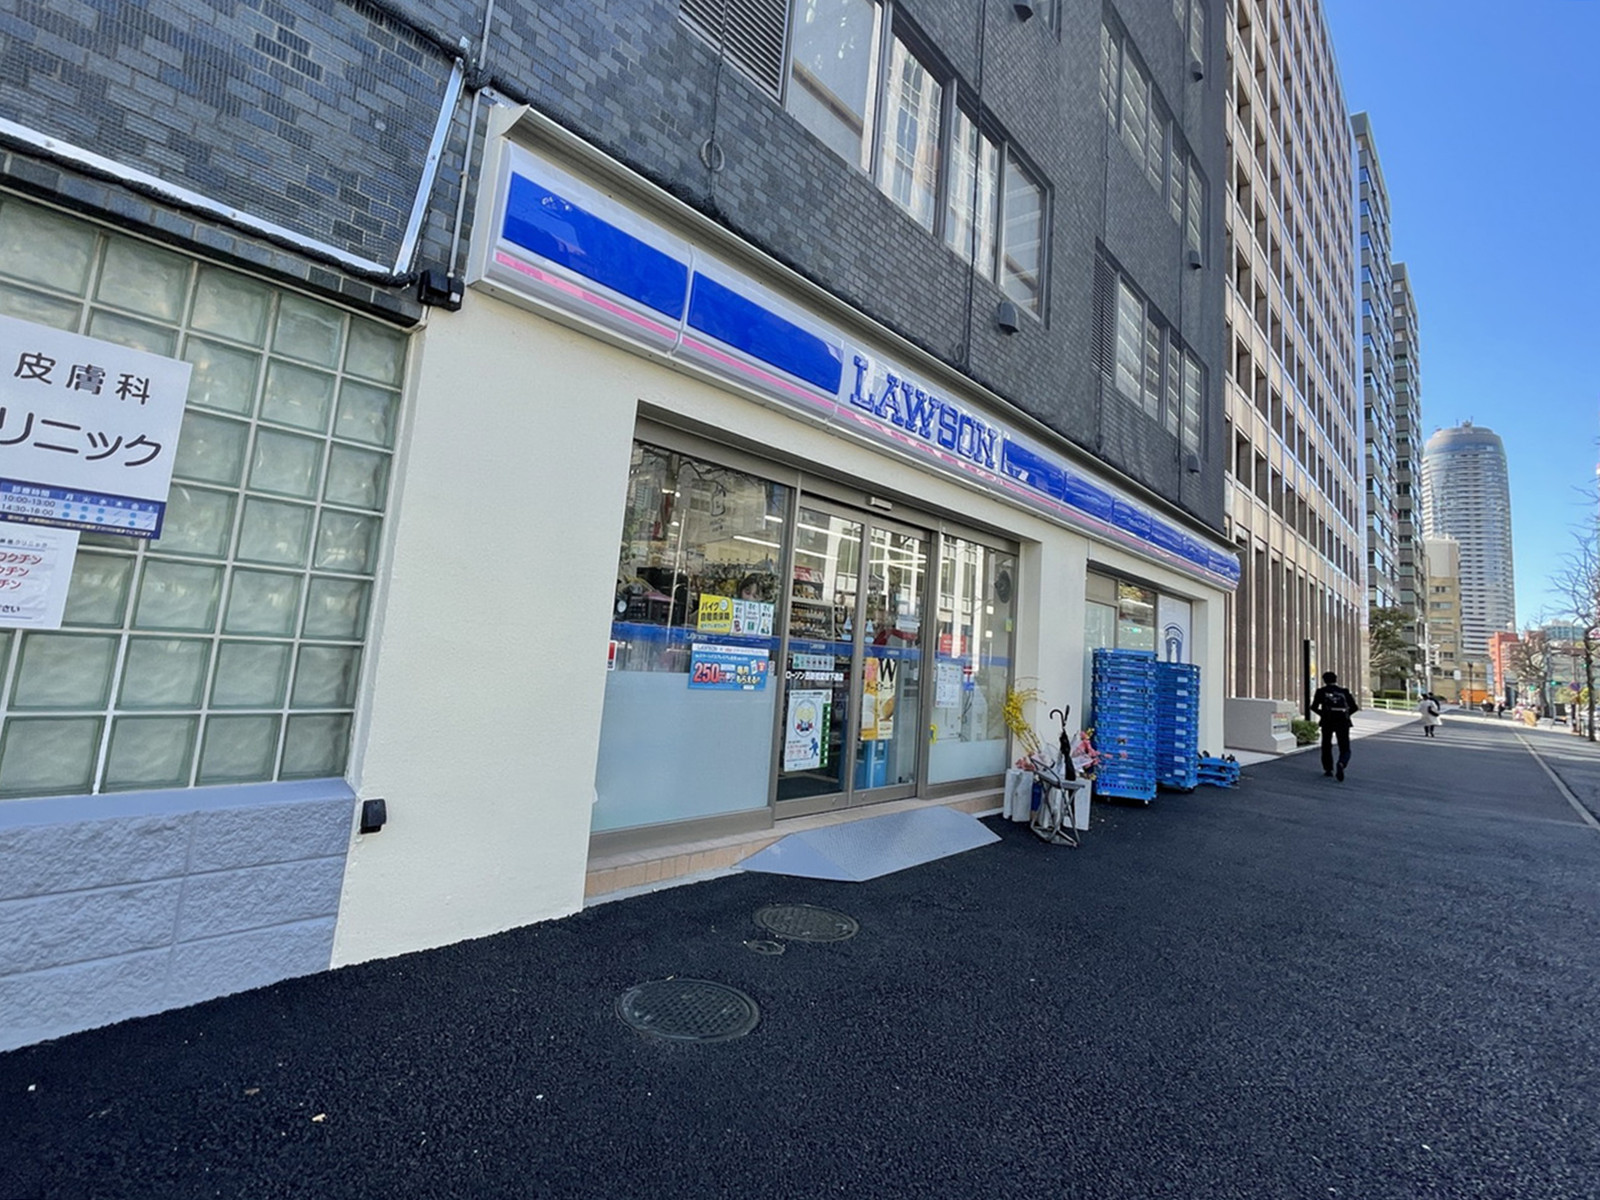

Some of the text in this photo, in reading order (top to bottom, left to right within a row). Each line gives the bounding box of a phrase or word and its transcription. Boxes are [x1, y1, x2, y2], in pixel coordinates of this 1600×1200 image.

[14, 352, 150, 405] 皮膚科
[0, 407, 162, 467] リニック
[850, 355, 998, 470] LAWSON
[0, 603, 20, 613] さい
[701, 602, 720, 612] バイク
